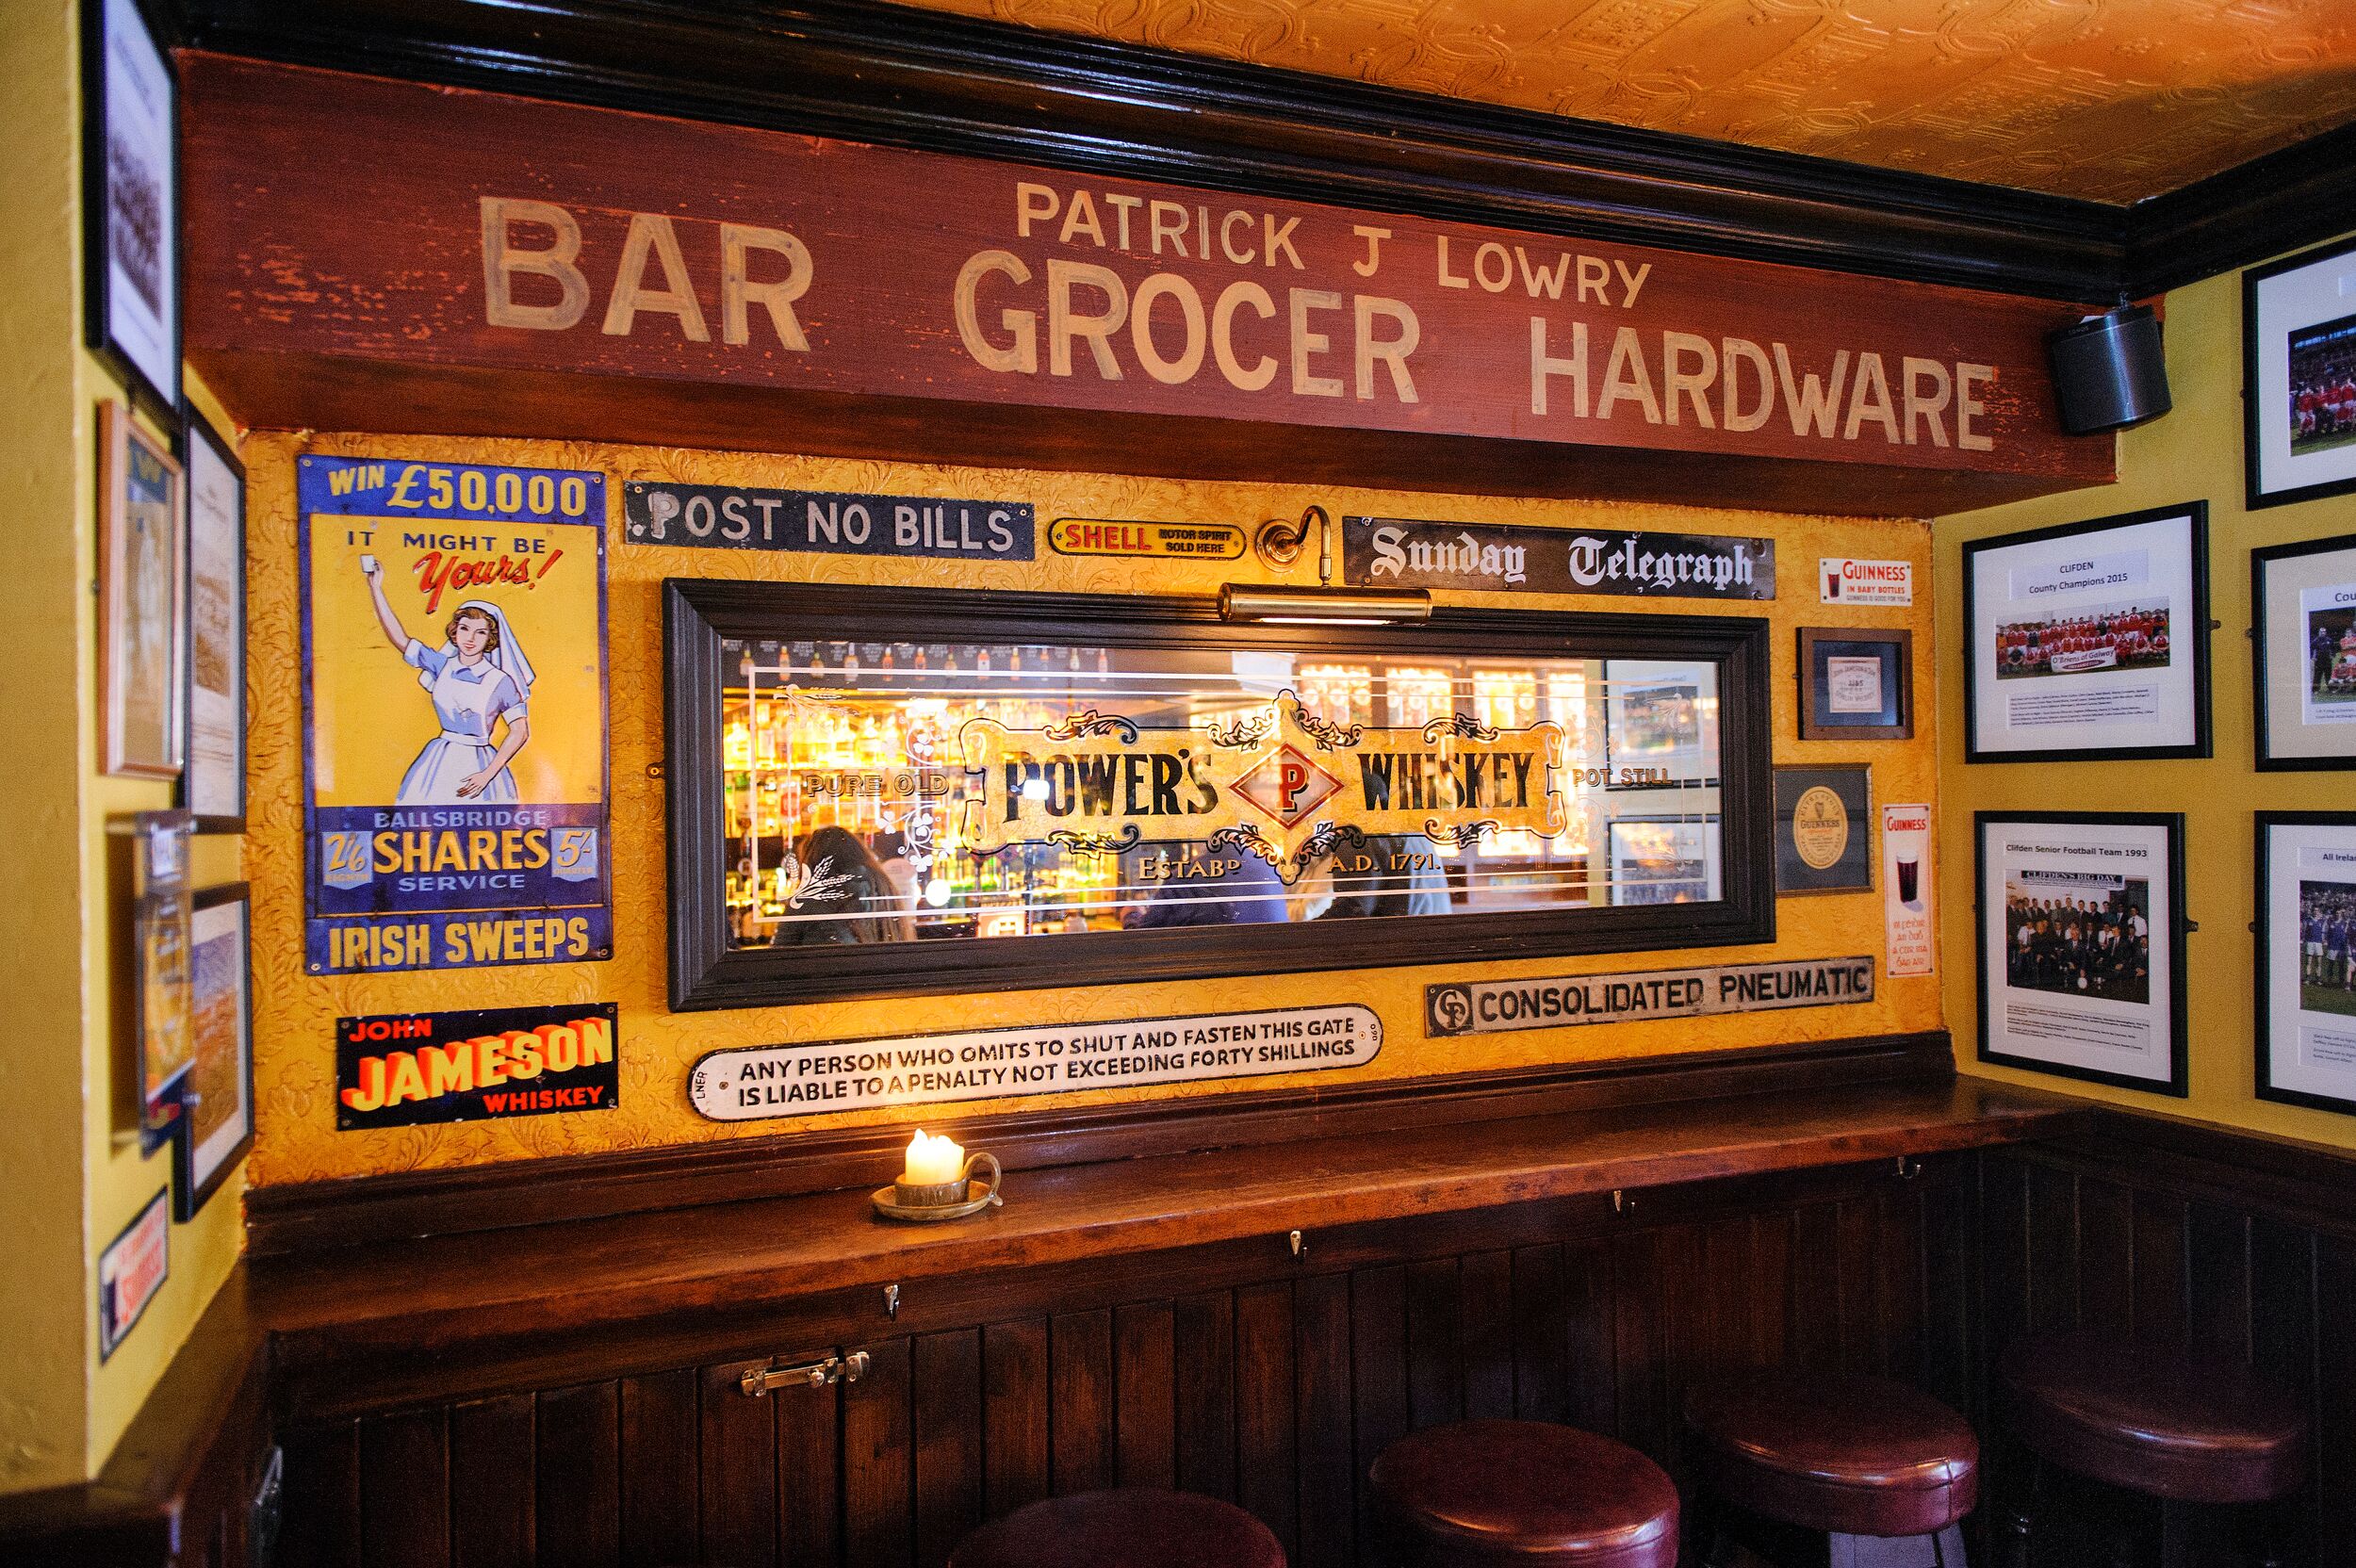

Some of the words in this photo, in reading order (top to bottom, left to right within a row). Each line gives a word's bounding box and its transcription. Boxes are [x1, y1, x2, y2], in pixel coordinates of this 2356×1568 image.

[1016, 182, 1305, 270] PATRICK
[1353, 226, 1392, 277] J
[1437, 235, 1652, 308] LOWRY
[480, 195, 810, 352] BAR
[954, 250, 1420, 403] GROCER
[1530, 317, 1997, 451] HARDWARE
[328, 466, 385, 497] WIN
[386, 465, 586, 516] £50,000
[647, 492, 782, 540] POST
[807, 501, 872, 545] NO
[895, 506, 1014, 552] BILLS
[347, 531, 374, 546] IT
[403, 532, 497, 552] MIGHT
[514, 537, 546, 554] BE
[1065, 524, 1153, 551] SHELL
[1158, 529, 1196, 540] MOTOR
[1198, 530, 1232, 541] SPIRIT
[1166, 542, 1195, 552] SOLD
[1196, 543, 1225, 553] HERE
[1370, 527, 1527, 583] Sunday
[1568, 536, 1753, 591] Telegraph
[1842, 561, 1906, 581] GUINNESS
[2059, 561, 2094, 574] CLIFDEN
[413, 549, 564, 615] Yours!
[1857, 585, 1875, 594] BABY
[1878, 586, 1906, 595] BOTTLES
[2029, 584, 2057, 594] County
[2059, 577, 2105, 590] Champions
[2106, 572, 2128, 583] 2015
[2088, 649, 2115, 660] Galway
[807, 774, 881, 798] PURE
[893, 773, 949, 796] OLD
[1003, 747, 1219, 824] POWER'S
[1276, 767, 1310, 812] P
[1358, 752, 1536, 811] WHISKEY
[1573, 767, 1612, 788] POT
[1620, 767, 1675, 788] STILL
[373, 810, 550, 828] BALLSBRIDGE
[1887, 815, 1926, 831] GUINNESS
[372, 828, 550, 874] SHARES
[2005, 844, 2034, 853] Clifden
[2035, 845, 2061, 854] Senior
[2063, 846, 2097, 856] Football
[2099, 848, 2122, 857] Team
[2124, 849, 2148, 858] 1993
[2335, 854, 2356, 862] Irela
[1327, 855, 1381, 874] A.D.
[399, 874, 525, 892] SERVICE
[329, 923, 430, 968] IRISH
[445, 917, 589, 963] SWEEPS
[1478, 976, 1704, 1022] CONSOLIDATED
[1719, 966, 1868, 1003] PNEUMATIC
[349, 1019, 433, 1042] JOHN
[740, 1059, 793, 1082] ANY
[799, 1051, 892, 1076] PERSON
[897, 1048, 955, 1068] WHO
[960, 1041, 1030, 1062] OMITS
[1037, 1039, 1063, 1056] TO
[1070, 1035, 1127, 1054] SHUT
[1132, 1031, 1177, 1050] AND
[1184, 1024, 1256, 1046] FASTEN
[1260, 1021, 1303, 1039] THIS
[1307, 1017, 1354, 1036] GATE
[341, 1017, 613, 1112] JAMESON
[739, 1086, 761, 1107] IS
[766, 1081, 848, 1104] LIABLE
[857, 1076, 885, 1096] TO
[888, 1075, 905, 1094] A
[908, 1067, 1007, 1092] PENALTY
[1013, 1064, 1058, 1083] NOT
[1067, 1053, 1185, 1079] EXCEEDING
[1190, 1046, 1255, 1067] FORTY
[1258, 1038, 1355, 1062] SHILLINGS
[695, 1070, 708, 1100] LNER
[483, 1086, 604, 1114] WHISKEY
